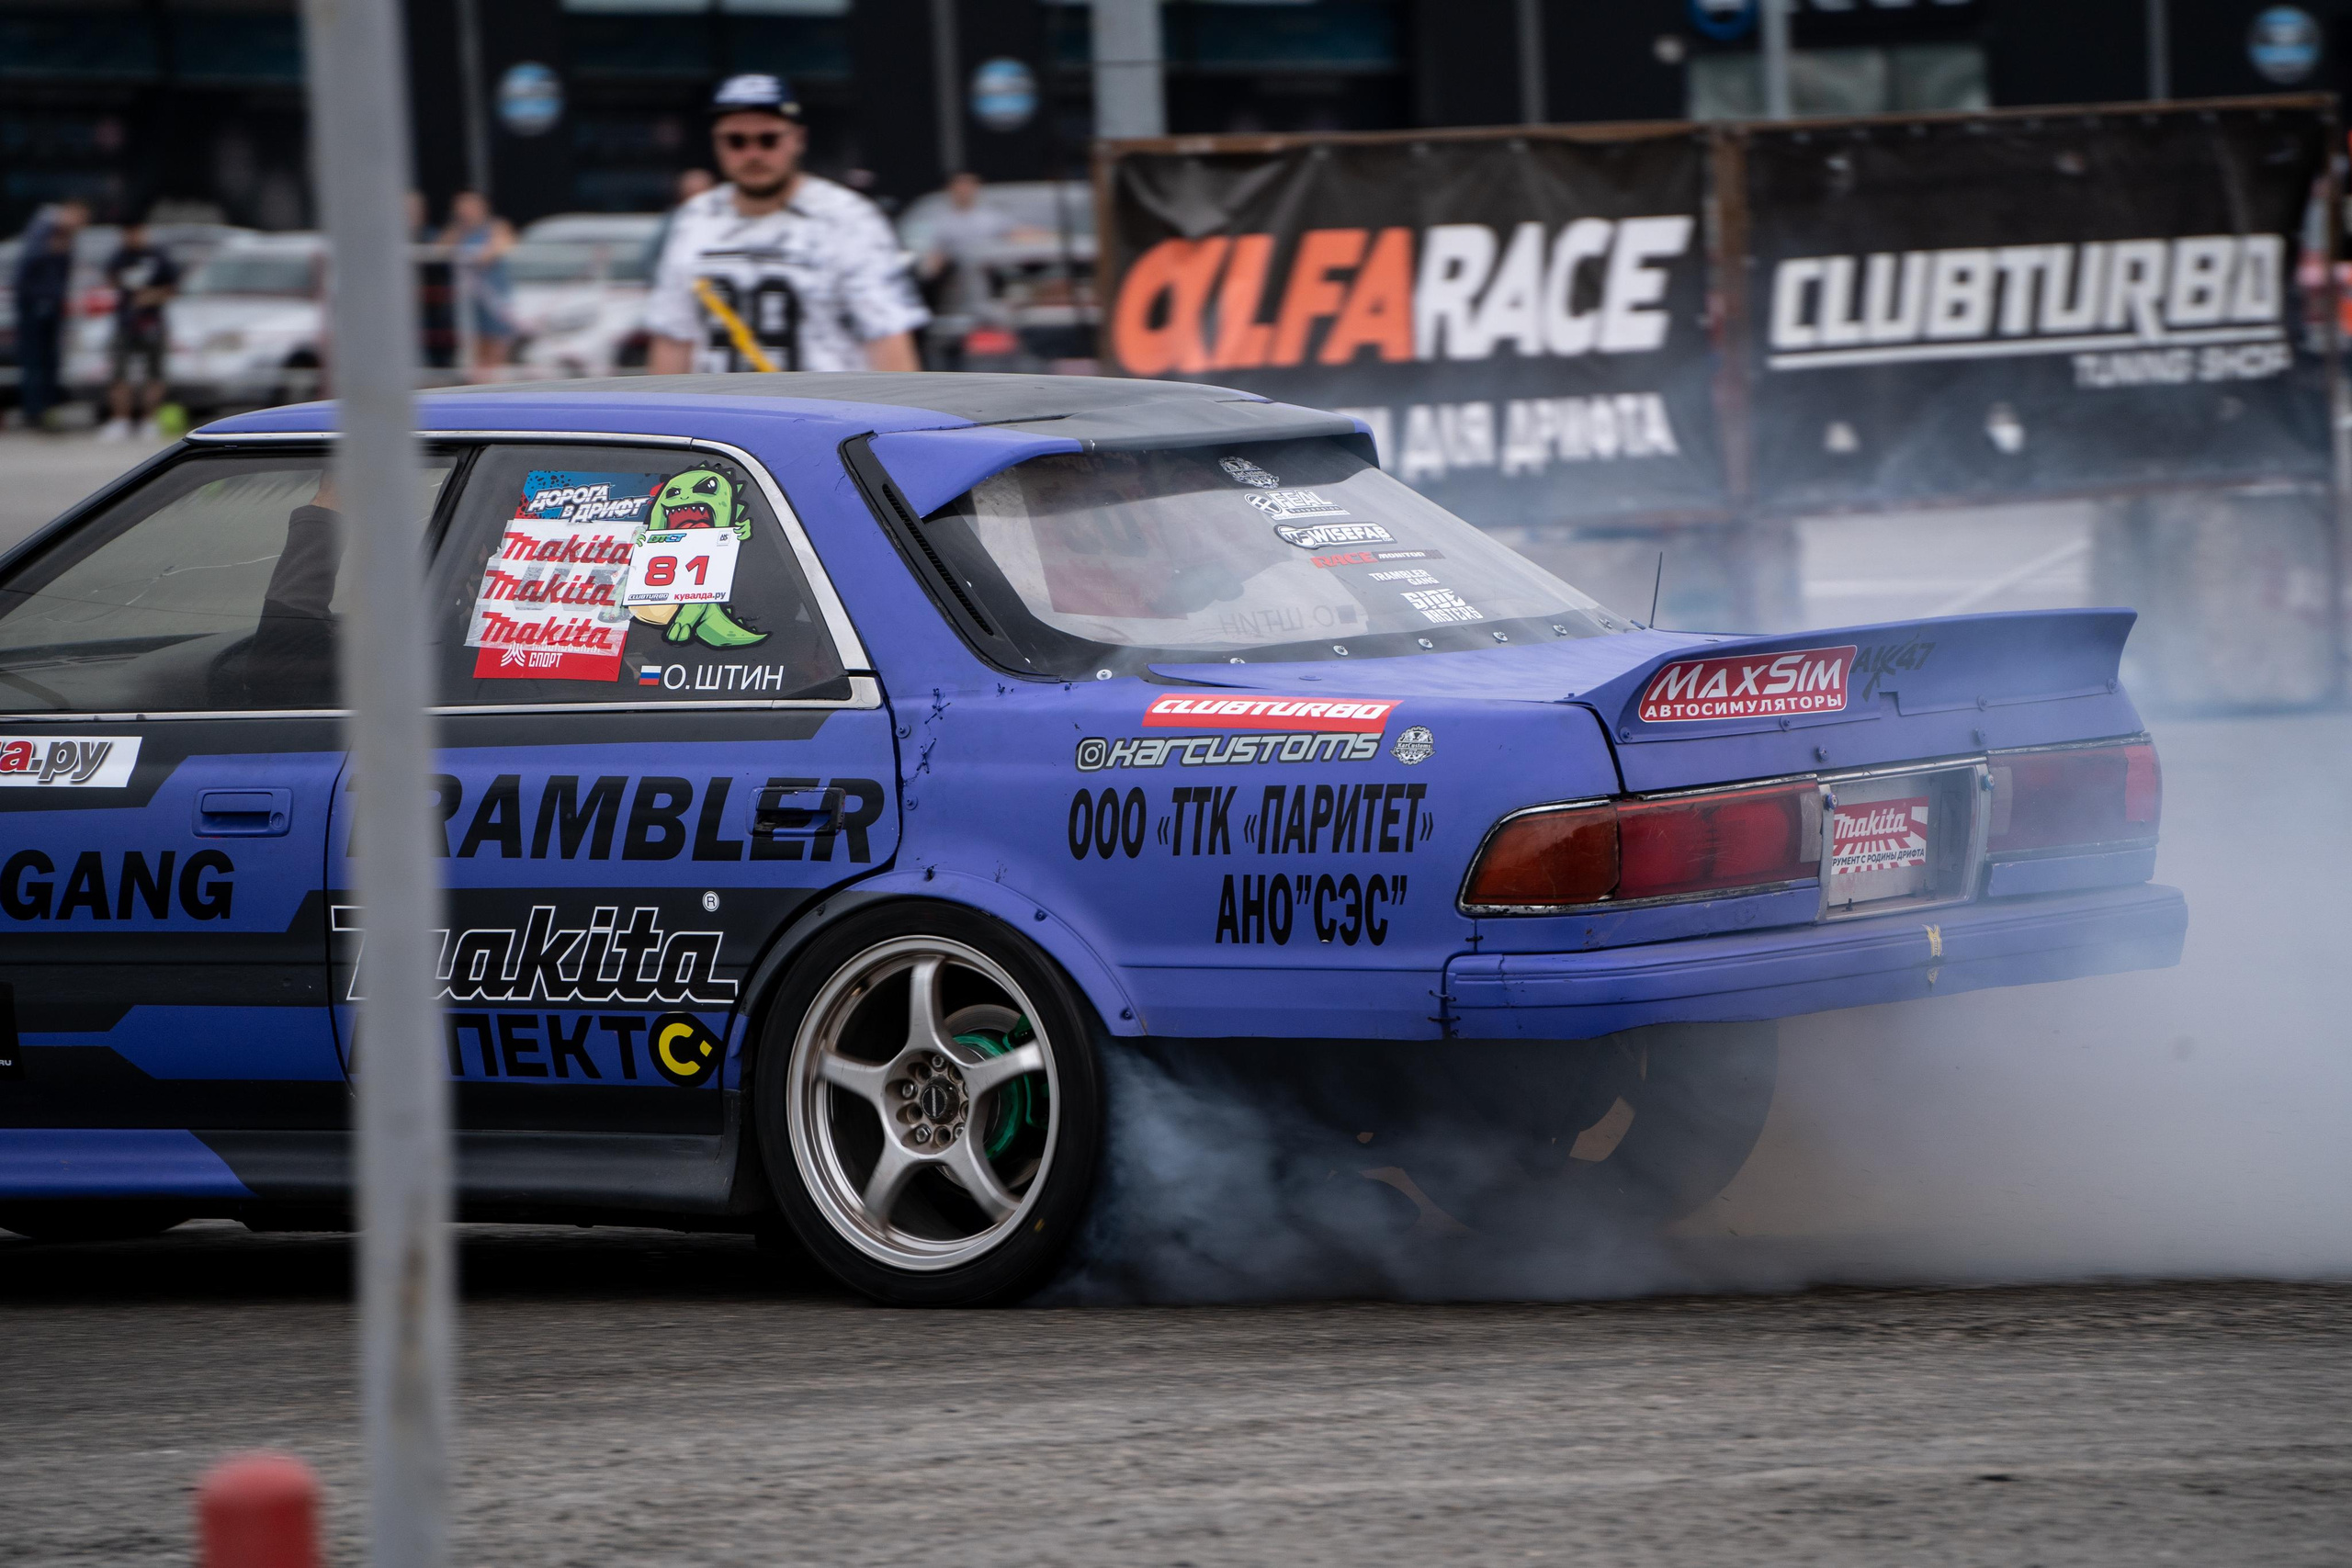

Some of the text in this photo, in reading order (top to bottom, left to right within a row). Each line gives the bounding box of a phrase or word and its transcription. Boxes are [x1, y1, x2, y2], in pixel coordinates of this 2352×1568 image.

[1769, 233, 2285, 349] CLUBTURBO
[526, 483, 611, 513] ДОРОГА
[1268, 490, 1335, 508] FEAL
[570, 496, 651, 523] ДРИФТ
[1307, 526, 1391, 542] WISEFAB
[1310, 551, 1378, 569] RACE
[644, 556, 710, 586] 81
[1368, 570, 1431, 581] TRAMBLER
[1407, 577, 1441, 586] GANG
[673, 592, 727, 602] кувалда.ру
[528, 652, 563, 667] СПОРТ
[1151, 700, 1390, 719] CLUBTURBO
[1645, 694, 1842, 717] АВТОСИМУЛЯТОРЫ
[0, 740, 111, 781] а.ру
[1068, 783, 1434, 860] ООО «ТТК «ПАРИТЕТ»
[1867, 852, 1896, 863] РОДИНЫ
[1897, 848, 1925, 861] ДРИФТА
[0, 850, 235, 921] GANG
